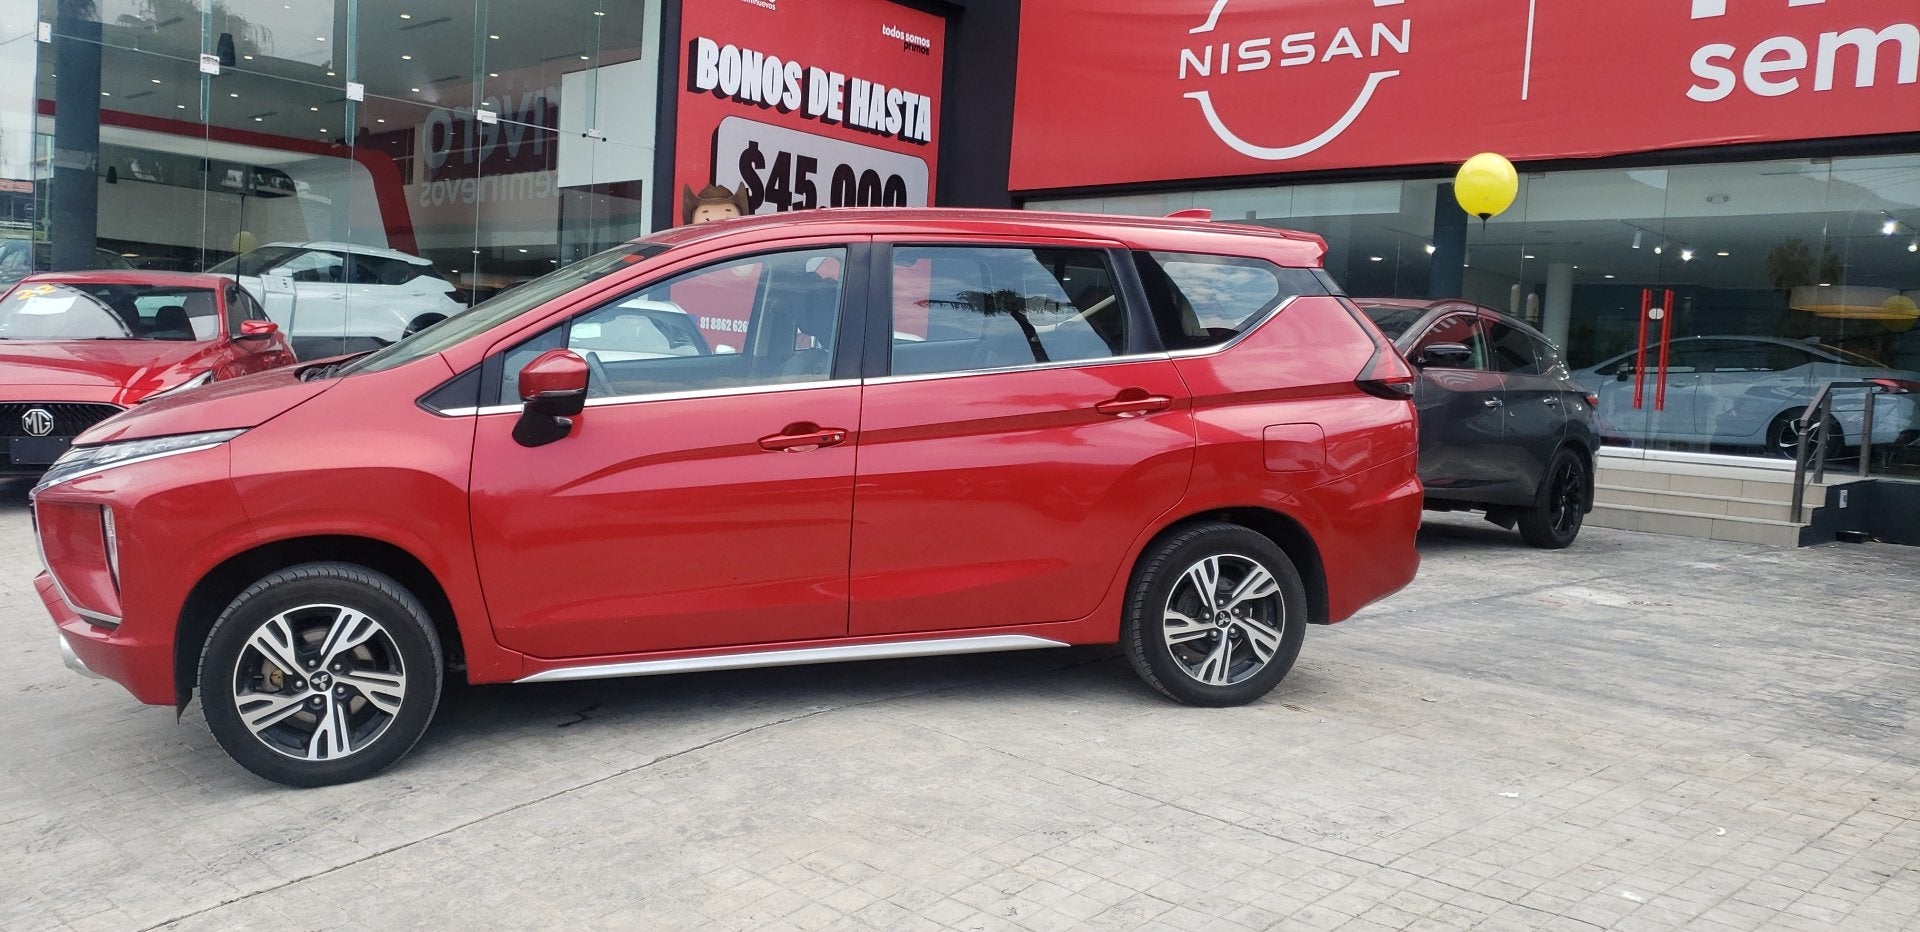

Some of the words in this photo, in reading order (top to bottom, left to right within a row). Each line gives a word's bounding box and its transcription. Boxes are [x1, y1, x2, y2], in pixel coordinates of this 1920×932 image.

[882, 24, 905, 40] todos
[905, 33, 931, 48] somos
[903, 41, 930, 56] primos
[1179, 19, 1411, 80] NISSAN
[695, 37, 802, 111] BONOS
[807, 66, 845, 123] DE
[850, 77, 931, 142] HASTA
[739, 140, 908, 216] $45000
[700, 316, 710, 330] 81
[711, 317, 732, 332] 8862
[732, 320, 750, 333] 626
[24, 411, 51, 434] MG
